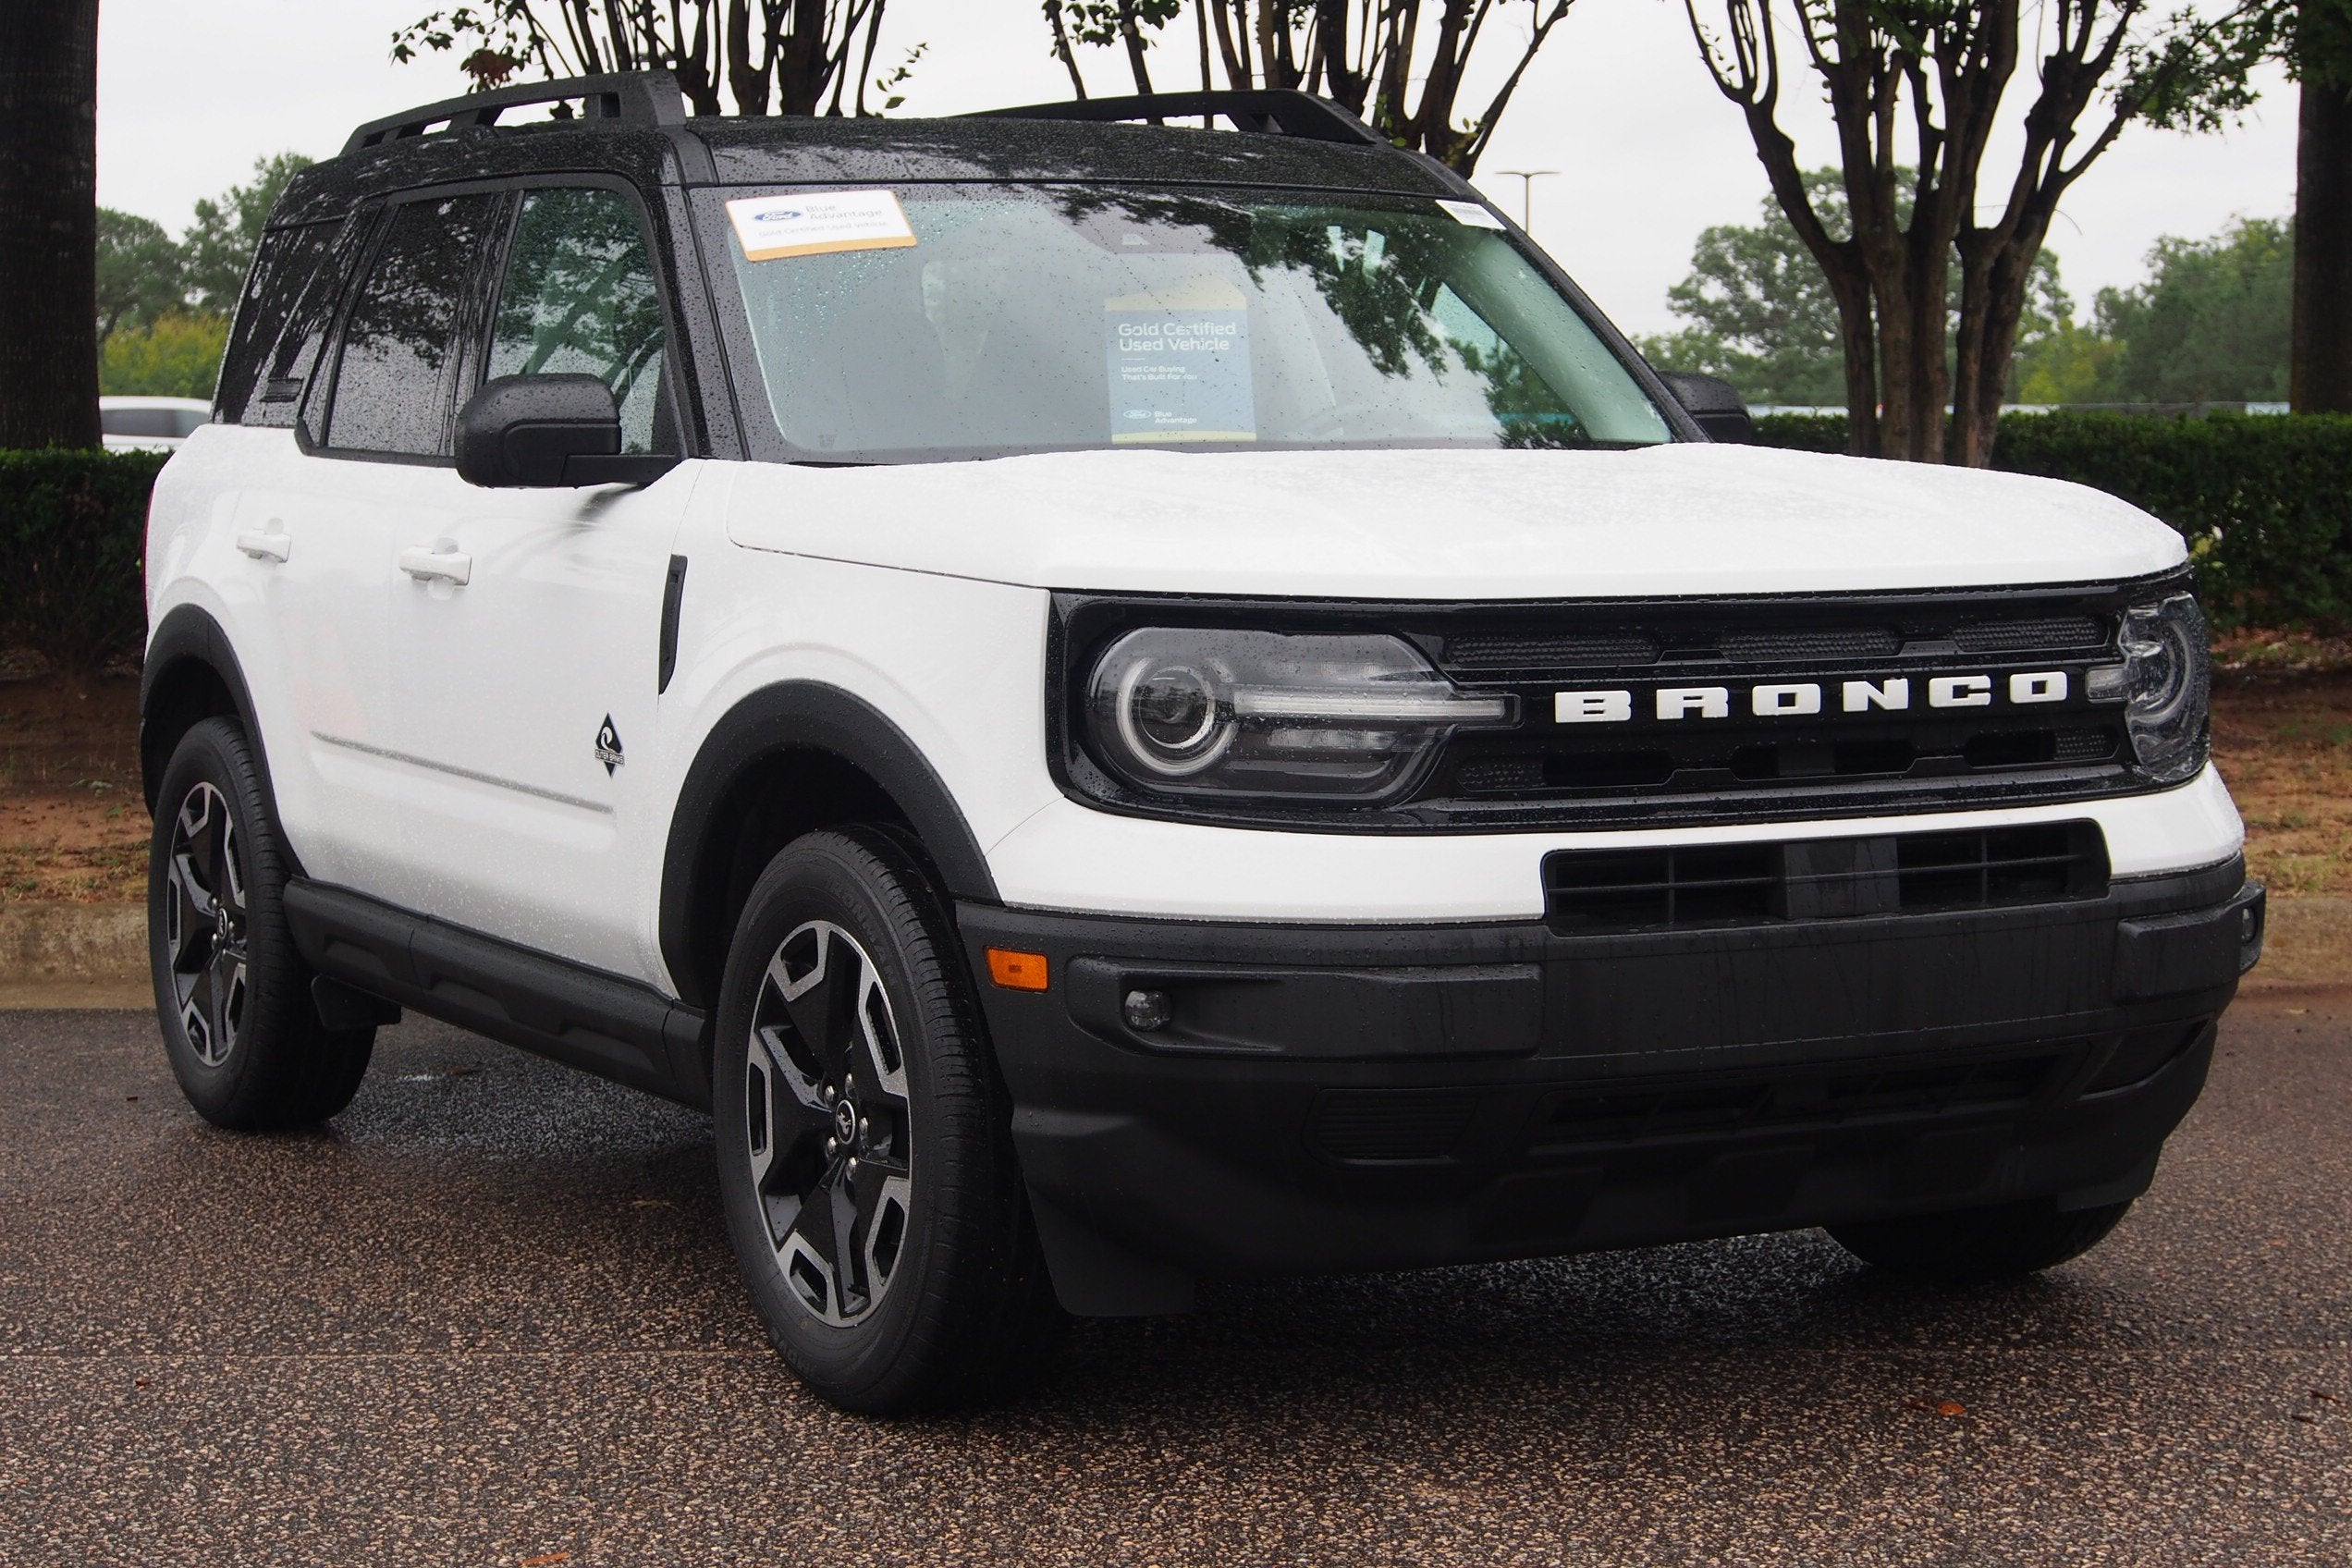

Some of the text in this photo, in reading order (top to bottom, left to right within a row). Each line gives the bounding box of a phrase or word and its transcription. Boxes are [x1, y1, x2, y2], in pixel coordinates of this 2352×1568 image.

[805, 204, 836, 214] Blue
[809, 208, 884, 221] Advantage
[1118, 321, 1237, 337] Gold Certified
[1119, 337, 1230, 351] Used Vehicle
[1158, 366, 1186, 374] Buying
[1554, 671, 2068, 723] BRONCO
